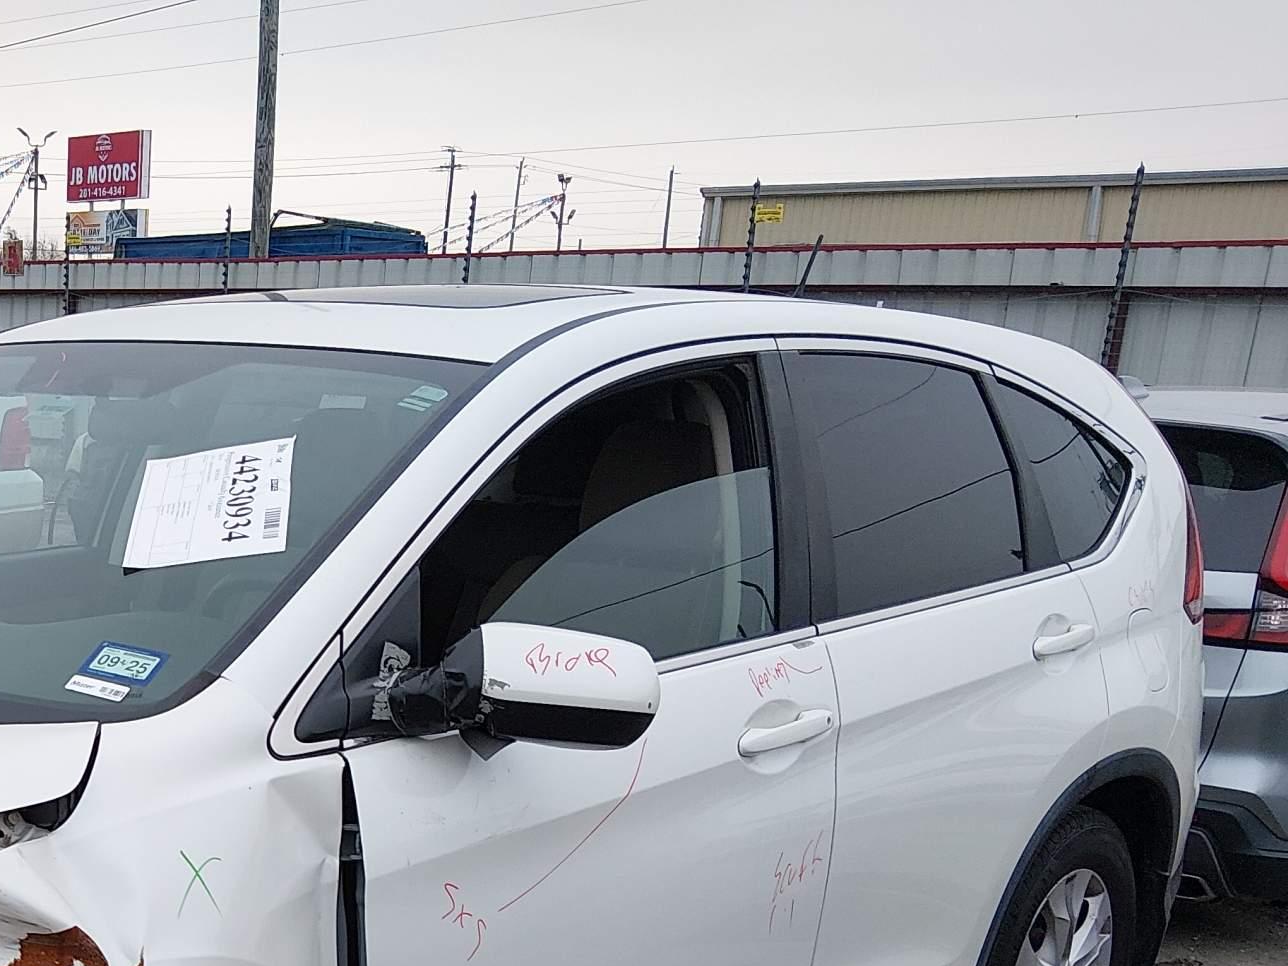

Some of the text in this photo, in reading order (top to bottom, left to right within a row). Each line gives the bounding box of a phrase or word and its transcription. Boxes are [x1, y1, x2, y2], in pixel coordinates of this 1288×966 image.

[70, 162, 137, 185] JB MOTORS
[221, 454, 263, 543] 44230934
[97, 653, 151, 674] 09 25
